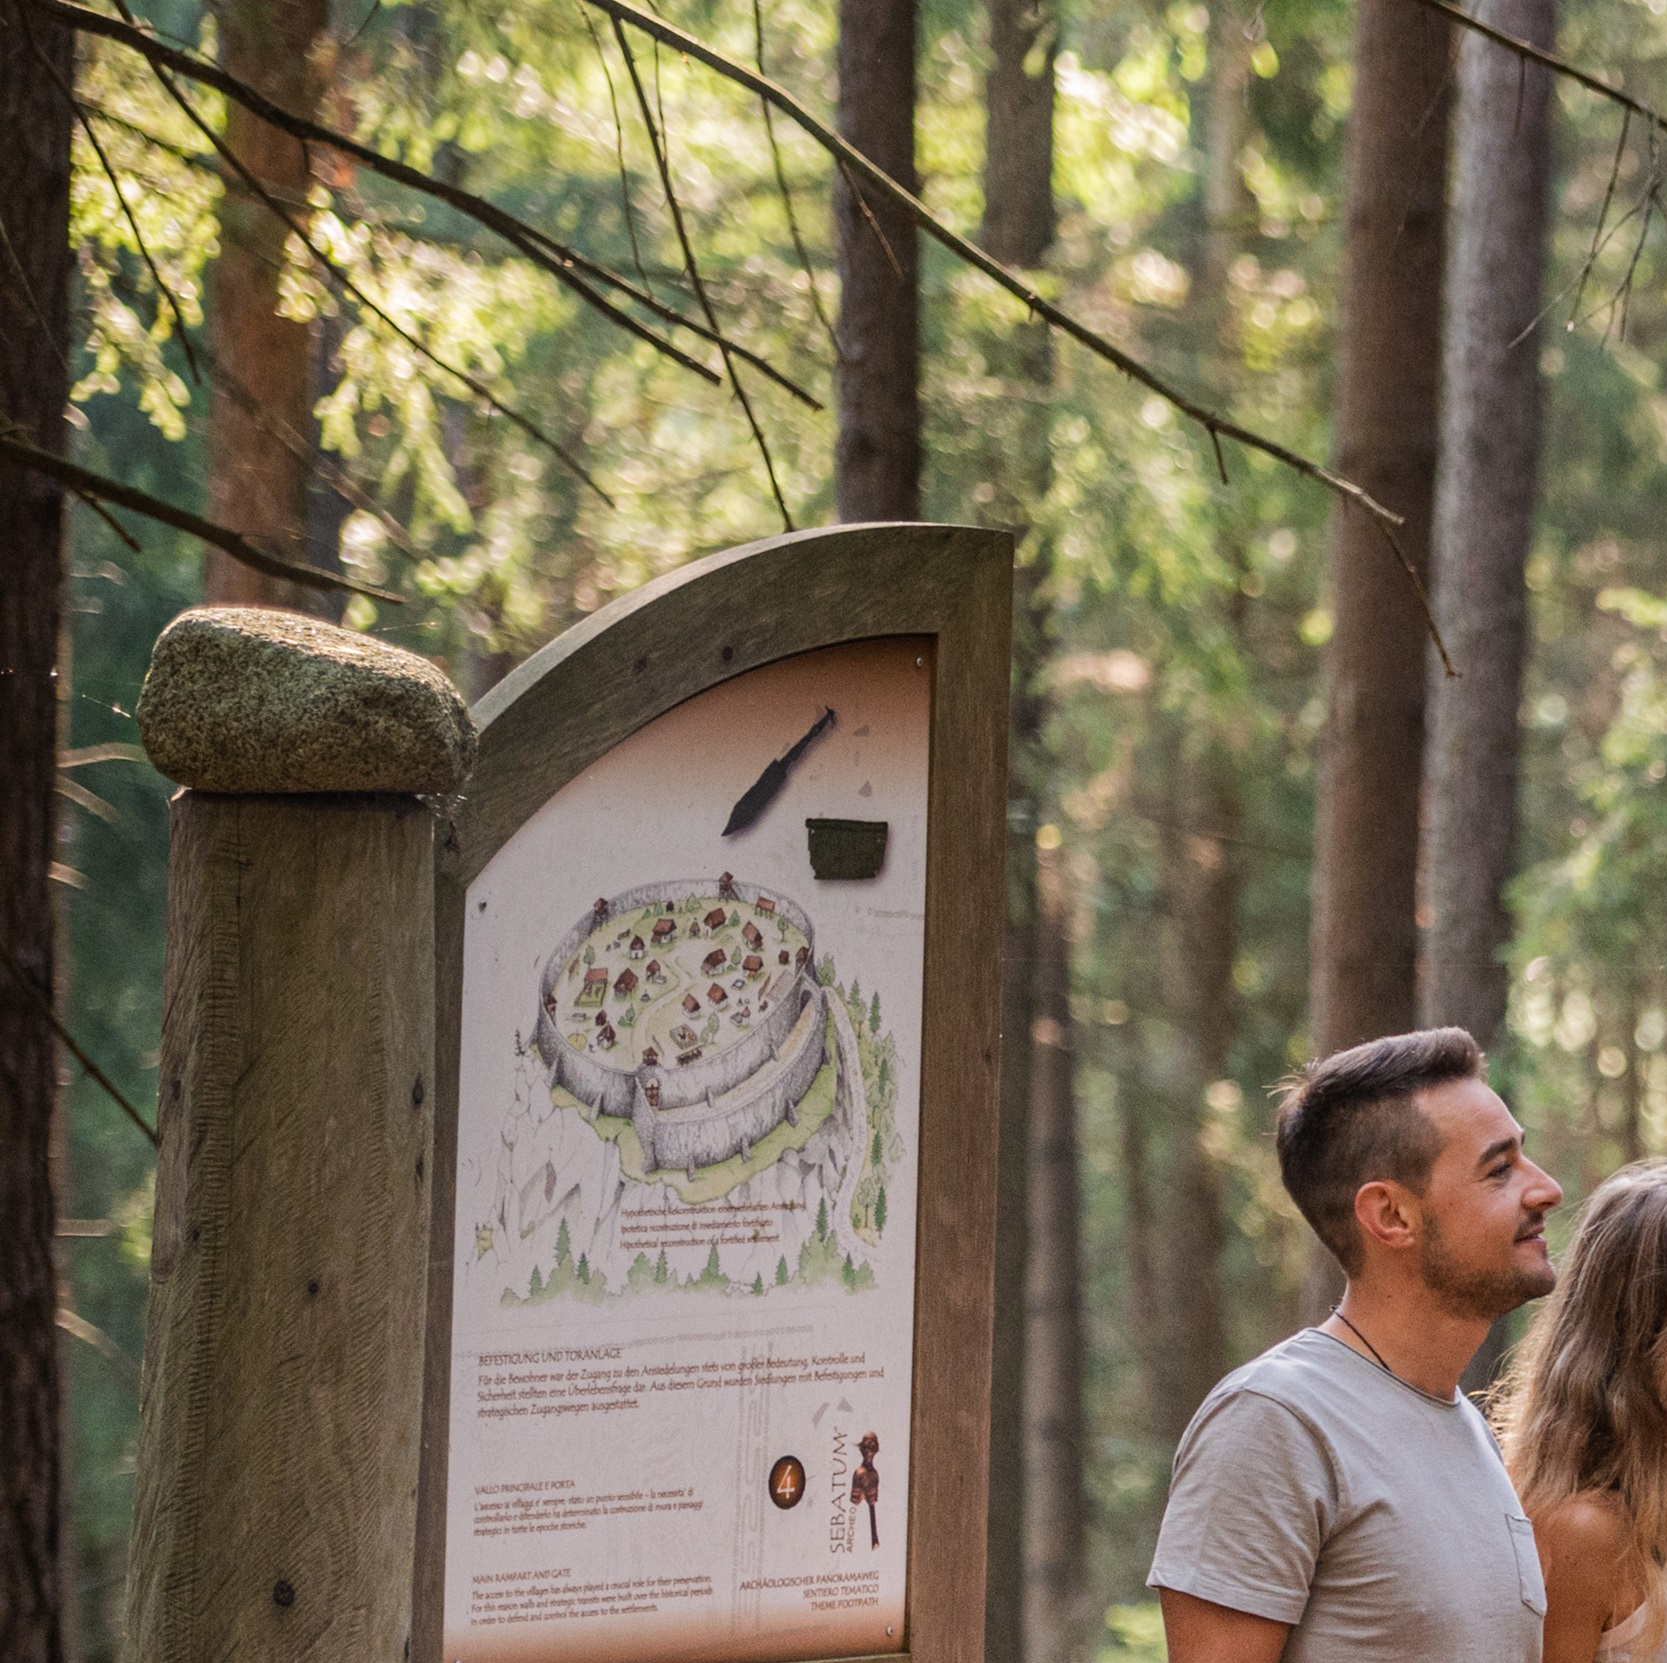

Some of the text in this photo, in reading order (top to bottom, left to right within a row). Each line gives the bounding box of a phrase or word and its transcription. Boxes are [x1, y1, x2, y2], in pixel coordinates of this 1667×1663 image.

[478, 1348, 622, 1367] BEFESTIGUNG UND TORANLAGE
[478, 1374, 492, 1386] Für
[493, 1373, 507, 1385] die
[508, 1371, 548, 1384] Bewohner
[550, 1373, 564, 1382] war
[565, 1369, 579, 1381] der
[580, 1368, 611, 1383] Zugang
[612, 1370, 623, 1378] zu
[624, 1366, 640, 1378] den
[641, 1363, 700, 1378] Ansiedelungen
[701, 1361, 719, 1373] stets
[721, 1363, 736, 1372] von
[738, 1359, 764, 1375] großer
[811, 1354, 849, 1367] Kontrolle
[851, 1353, 865, 1365] und
[477, 1388, 516, 1402] Sicherheit
[518, 1387, 547, 1399] stellten
[549, 1386, 566, 1398] eine
[568, 1382, 631, 1397] Überlebensfrage
[649, 1380, 666, 1392] Aus
[668, 1379, 695, 1391] diesem
[696, 1376, 722, 1389] Grund
[724, 1375, 753, 1387] wurden
[755, 1373, 797, 1388] Siedlungen
[799, 1371, 812, 1383] mit
[814, 1369, 867, 1385] Befestigungen
[869, 1367, 885, 1379] und
[477, 1403, 529, 1420] strategischen
[530, 1402, 590, 1418] Zugangswegen
[474, 1479, 576, 1495] VALLO PRINCIPALE E PORTA
[776, 1464, 796, 1499] 4
[829, 1430, 848, 1553] SEBATUM
[846, 1506, 858, 1552] ARCHEO
[473, 1568, 571, 1584] MAIN RAMPART AND GATE
[739, 1570, 880, 1591] ARCHÄOLOGISCHER PANORAMAWEG
[472, 1590, 484, 1600] The
[506, 1588, 513, 1597] to
[514, 1587, 525, 1597] the
[527, 1585, 549, 1598] villages
[551, 1584, 561, 1594] has
[563, 1583, 582, 1596] always
[584, 1581, 604, 1595] played
[611, 1579, 631, 1590] crucial
[633, 1578, 645, 1588] role
[646, 1577, 656, 1587] for
[658, 1576, 672, 1586] their
[803, 1583, 880, 1599] SENTIERO TEMATICO
[471, 1603, 482, 1613] For
[484, 1602, 496, 1612] this
[536, 1598, 549, 1608] and
[550, 1596, 576, 1609] strategic
[601, 1596, 617, 1604] were
[649, 1590, 660, 1600] the
[661, 1588, 689, 1599] historical
[811, 1597, 879, 1611] THEME FOOTPATH
[479, 1615, 497, 1625] order
[498, 1614, 506, 1624] to
[507, 1612, 528, 1623] defend
[530, 1611, 542, 1621] and
[569, 1608, 579, 1618] the
[601, 1606, 608, 1616] to
[609, 1605, 620, 1615] the
